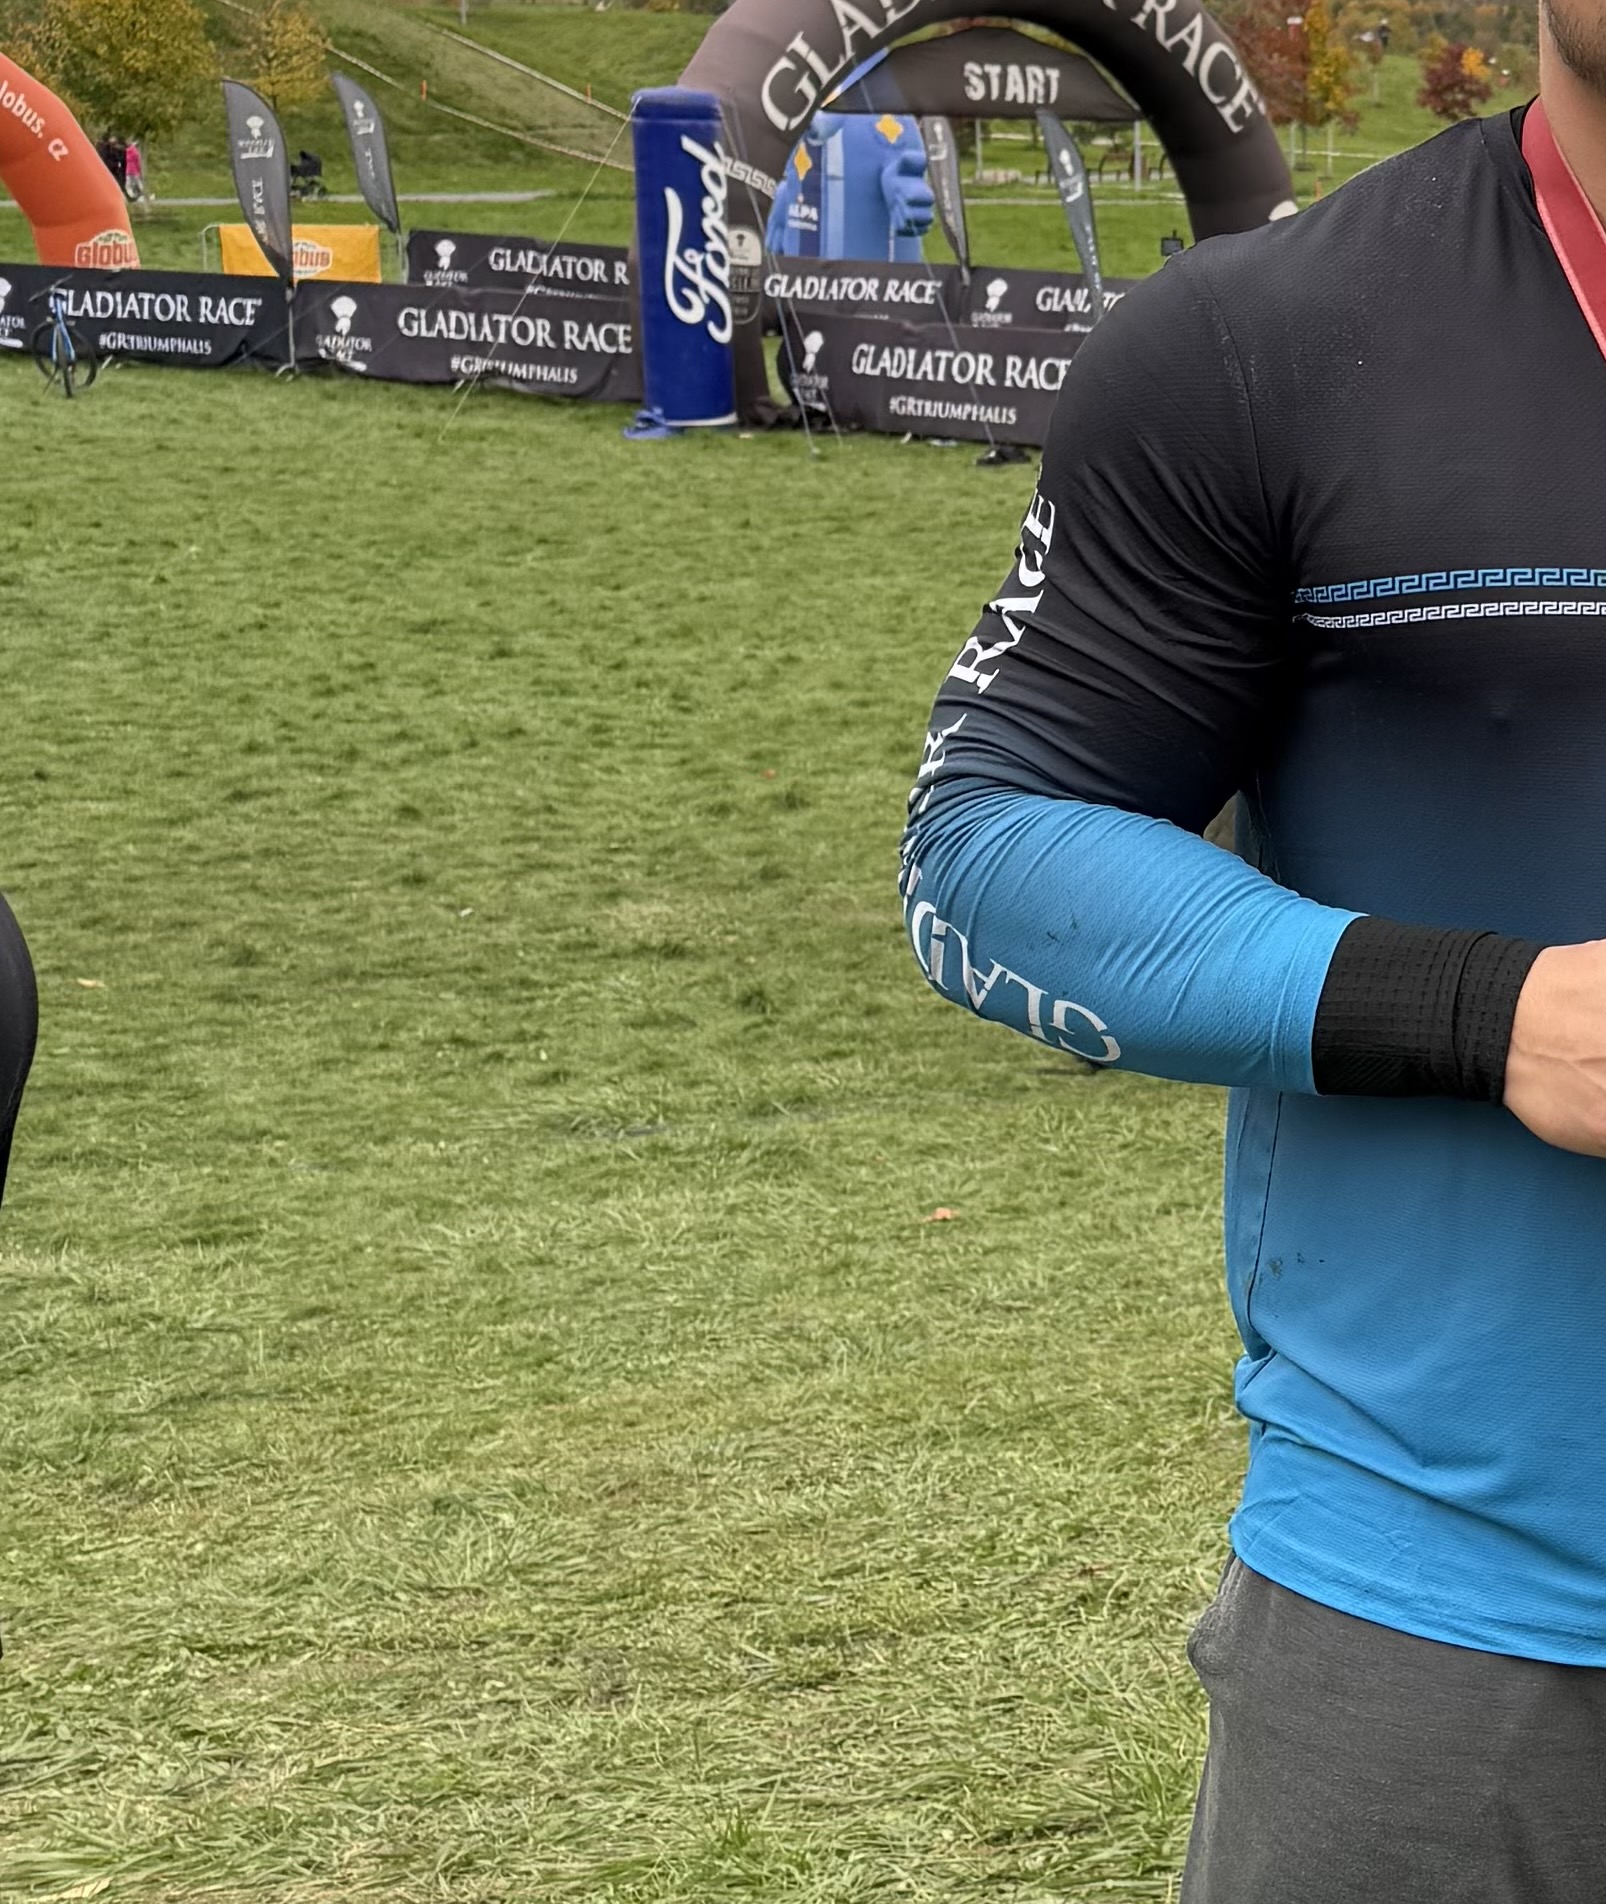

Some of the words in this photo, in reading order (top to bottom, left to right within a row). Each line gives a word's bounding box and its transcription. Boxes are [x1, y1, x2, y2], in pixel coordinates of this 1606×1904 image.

[963, 62, 1061, 104] START
[664, 134, 733, 344] Ford
[489, 246, 605, 283] GLADIATOR
[764, 273, 880, 302] GLADIATOR
[885, 278, 937, 305] RACE
[199, 296, 256, 326] RACE
[397, 307, 557, 350] GLADIATOR
[563, 321, 633, 354] RACE
[852, 343, 996, 387] GLADIATOR
